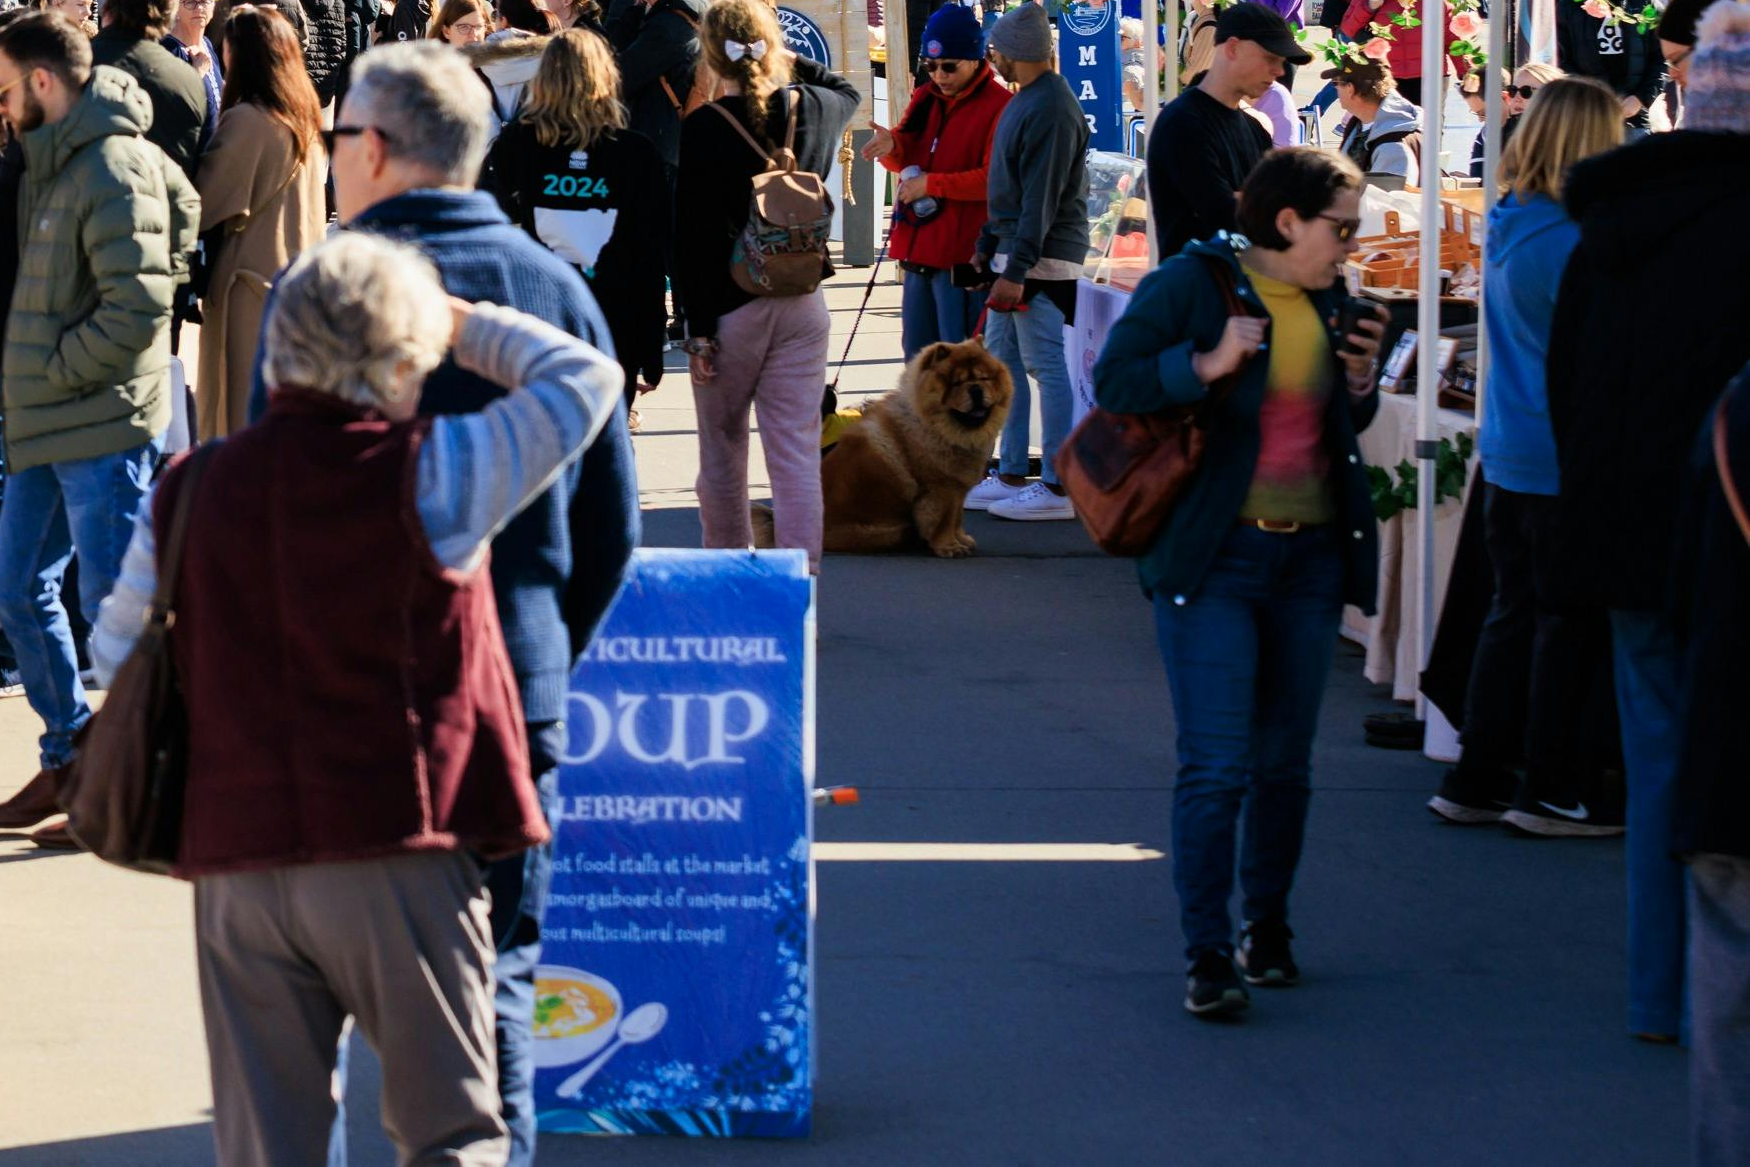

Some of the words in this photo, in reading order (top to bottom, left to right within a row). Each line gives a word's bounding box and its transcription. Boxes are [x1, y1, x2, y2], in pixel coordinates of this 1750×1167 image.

[543, 174, 609, 198] 2024
[575, 852, 617, 874] food
[619, 852, 661, 875] stalls
[664, 857, 680, 875] at
[683, 853, 711, 875] the
[714, 853, 770, 875] market
[665, 886, 686, 908] of
[687, 892, 739, 912] unique
[571, 920, 672, 942] multicultural
[675, 924, 726, 946] soups!
